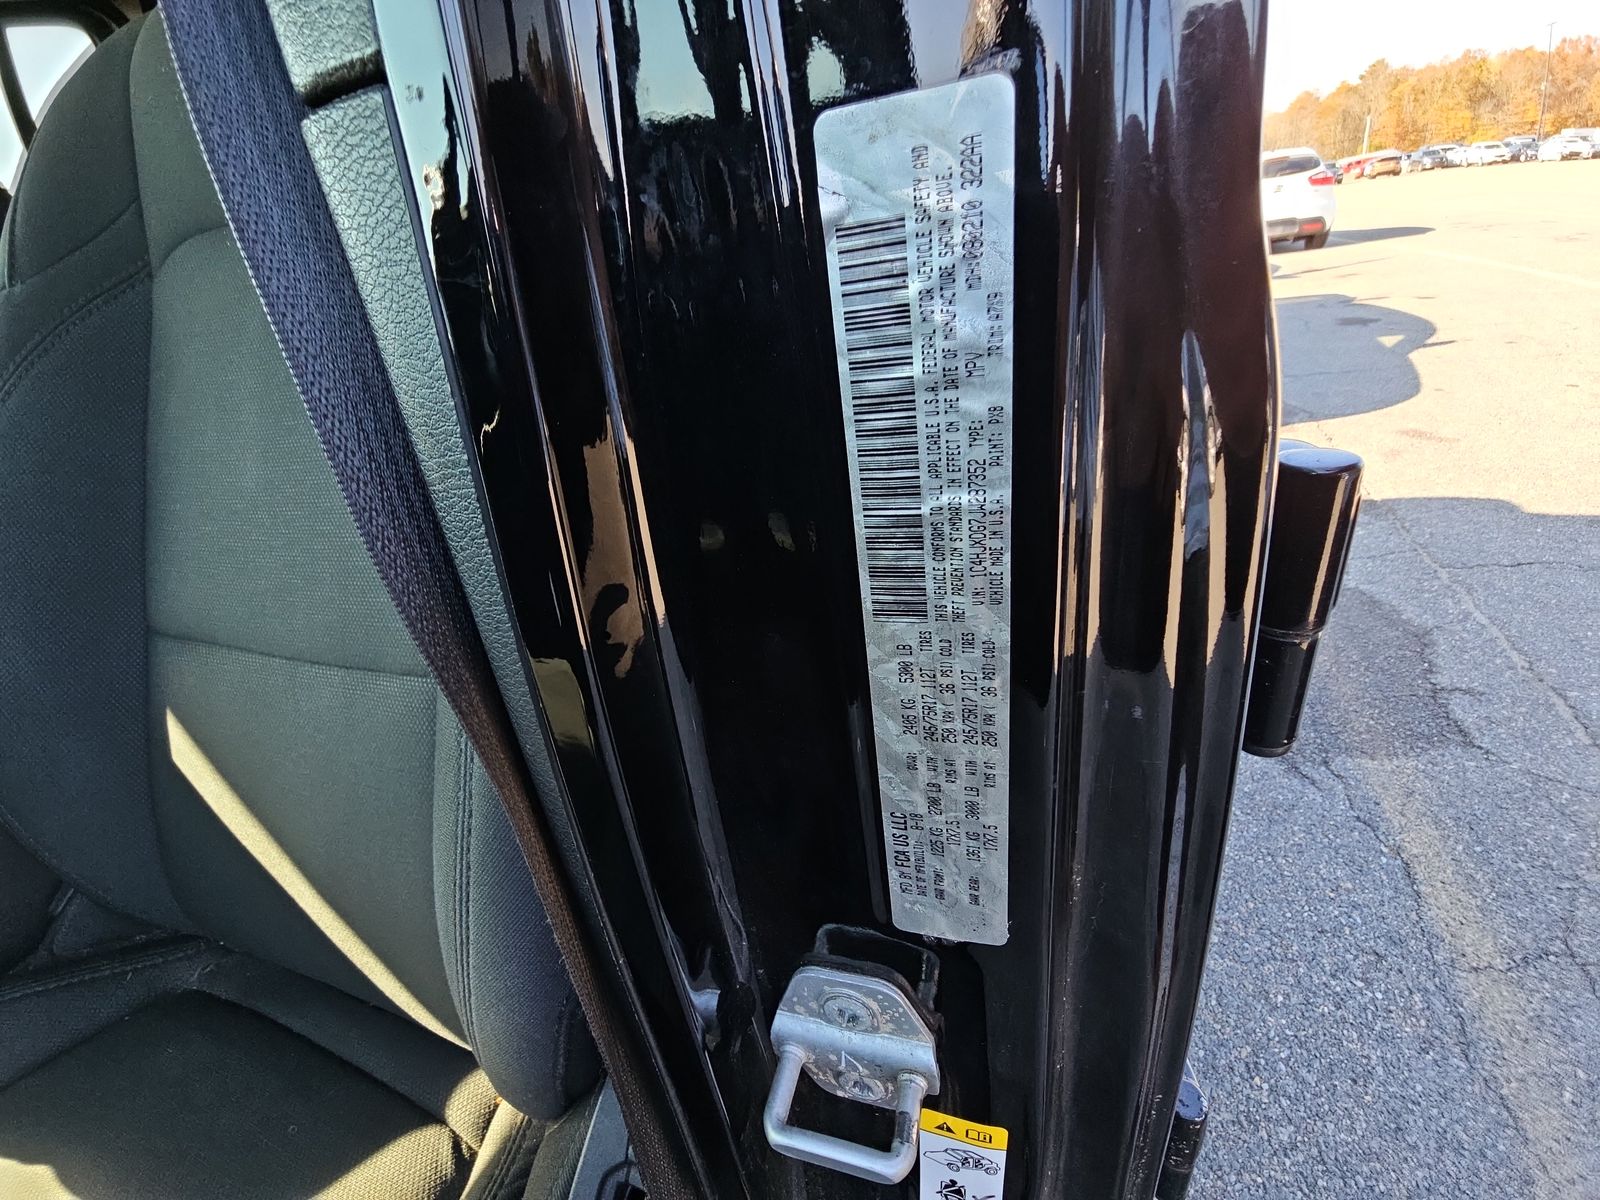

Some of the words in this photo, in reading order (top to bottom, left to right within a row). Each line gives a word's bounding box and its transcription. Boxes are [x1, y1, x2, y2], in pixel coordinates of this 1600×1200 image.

[911, 145, 928, 169] AND
[960, 134, 983, 190] 322AA
[935, 166, 953, 212] ABOVE.
[913, 178, 931, 223] SAFETY
[938, 218, 954, 257] SHOWN
[916, 230, 933, 282] VEHICLE
[919, 288, 934, 322] MOTOR
[939, 263, 957, 341] MANUFACTURE
[921, 329, 937, 375] FEDERAL
[942, 348, 957, 359] OF
[965, 352, 985, 378] MPV
[943, 366, 958, 390] DATE
[924, 381, 939, 416] U.S.A.
[944, 397, 959, 414] THE
[988, 406, 1003, 424] PX8
[945, 421, 960, 432] ON
[969, 420, 984, 447] TYPE:
[926, 422, 942, 479] APPLICABLE
[946, 440, 961, 472] EFFECT
[988, 433, 1003, 467] PAINT:
[929, 485, 943, 501] ALL
[947, 479, 961, 488] IN
[930, 507, 943, 516] TO
[948, 496, 963, 542] STANDARDS
[967, 459, 987, 578] 1C4HJXDG7JW287352
[989, 494, 1003, 525] U.S.A.
[931, 521, 945, 562] CONFORMS
[989, 531, 1003, 539] IN
[989, 546, 1003, 566] MADE
[950, 547, 964, 596] PREVENTION
[933, 567, 946, 600] VEHICLE
[989, 572, 1003, 605] VEHICLE
[972, 587, 985, 606] VIN:
[934, 604, 947, 622] THIS
[951, 601, 965, 623] THEFT
[896, 645, 912, 655] LB
[919, 631, 932, 652] TIRES
[939, 639, 952, 656] COLD
[962, 632, 975, 654] TIRES
[982, 641, 995, 658] COLD
[898, 661, 914, 683] 5300
[920, 667, 936, 689] 112T
[961, 670, 977, 691] 112T
[940, 684, 955, 694] 36
[981, 687, 996, 697] 36
[901, 699, 915, 710] KG
[902, 714, 917, 735] 2405
[921, 695, 938, 742] 245/75R17
[942, 711, 954, 723] KPA
[962, 697, 978, 745] 245/75R17
[983, 714, 995, 726] KPA
[941, 728, 957, 743] 250
[981, 731, 997, 747] 250
[927, 757, 938, 771] WITH
[964, 760, 976, 775] WITH
[983, 761, 995, 770] AT
[945, 769, 957, 783] RIMS
[984, 773, 996, 788] RIMS
[926, 783, 941, 793] LB
[964, 786, 979, 797] LB
[927, 797, 942, 815] 2700
[965, 801, 979, 820] 3000
[890, 812, 907, 831] LLC
[909, 813, 924, 830] 8-18
[892, 835, 909, 847] US
[928, 827, 943, 837] KG
[946, 820, 960, 846] 17X7.5
[966, 831, 980, 841] KG
[983, 825, 998, 851] 17X7.5
[930, 840, 944, 857] 1225
[966, 845, 980, 862] 1361
[894, 851, 911, 868] FCA
[899, 871, 912, 880] BY
[916, 885, 927, 897] DATE
